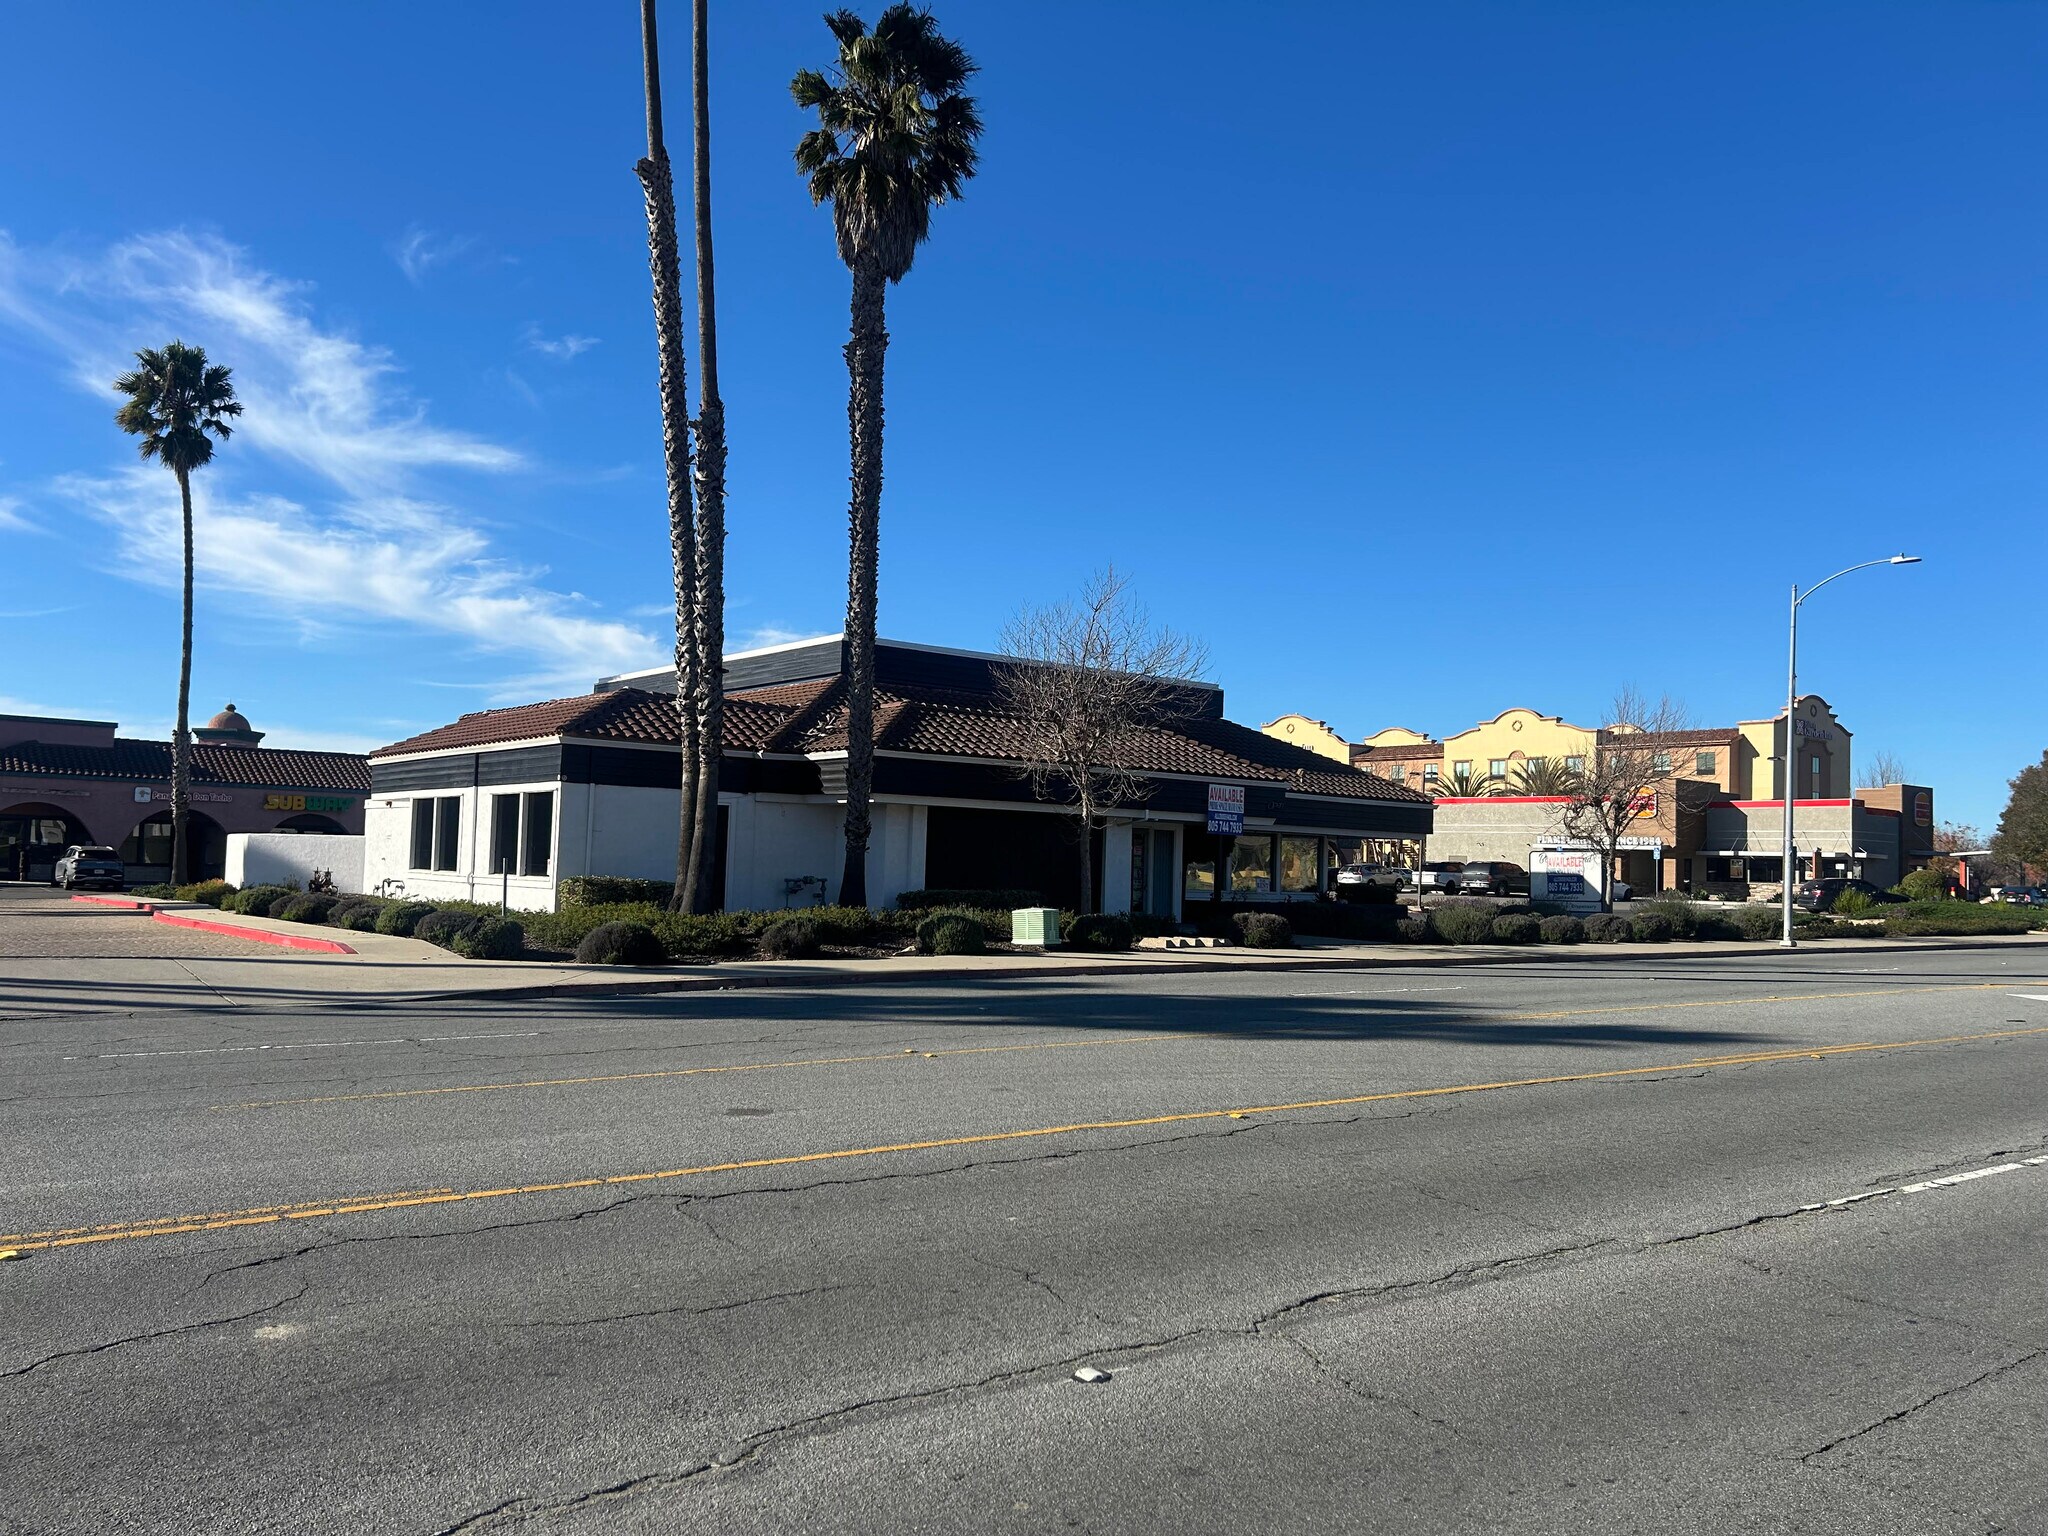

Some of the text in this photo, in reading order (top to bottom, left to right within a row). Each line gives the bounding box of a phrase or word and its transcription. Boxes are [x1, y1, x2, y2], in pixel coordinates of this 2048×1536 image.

[193, 792, 209, 801] Don
[1210, 787, 1244, 803] AVAILABLE
[264, 794, 356, 812] SUBWAY
[1208, 820, 1243, 834] 805 744 7933
[1639, 836, 1662, 846] 1984
[1548, 856, 1583, 867] AVAILABLE
[1548, 882, 1583, 891] 805 744 7933
